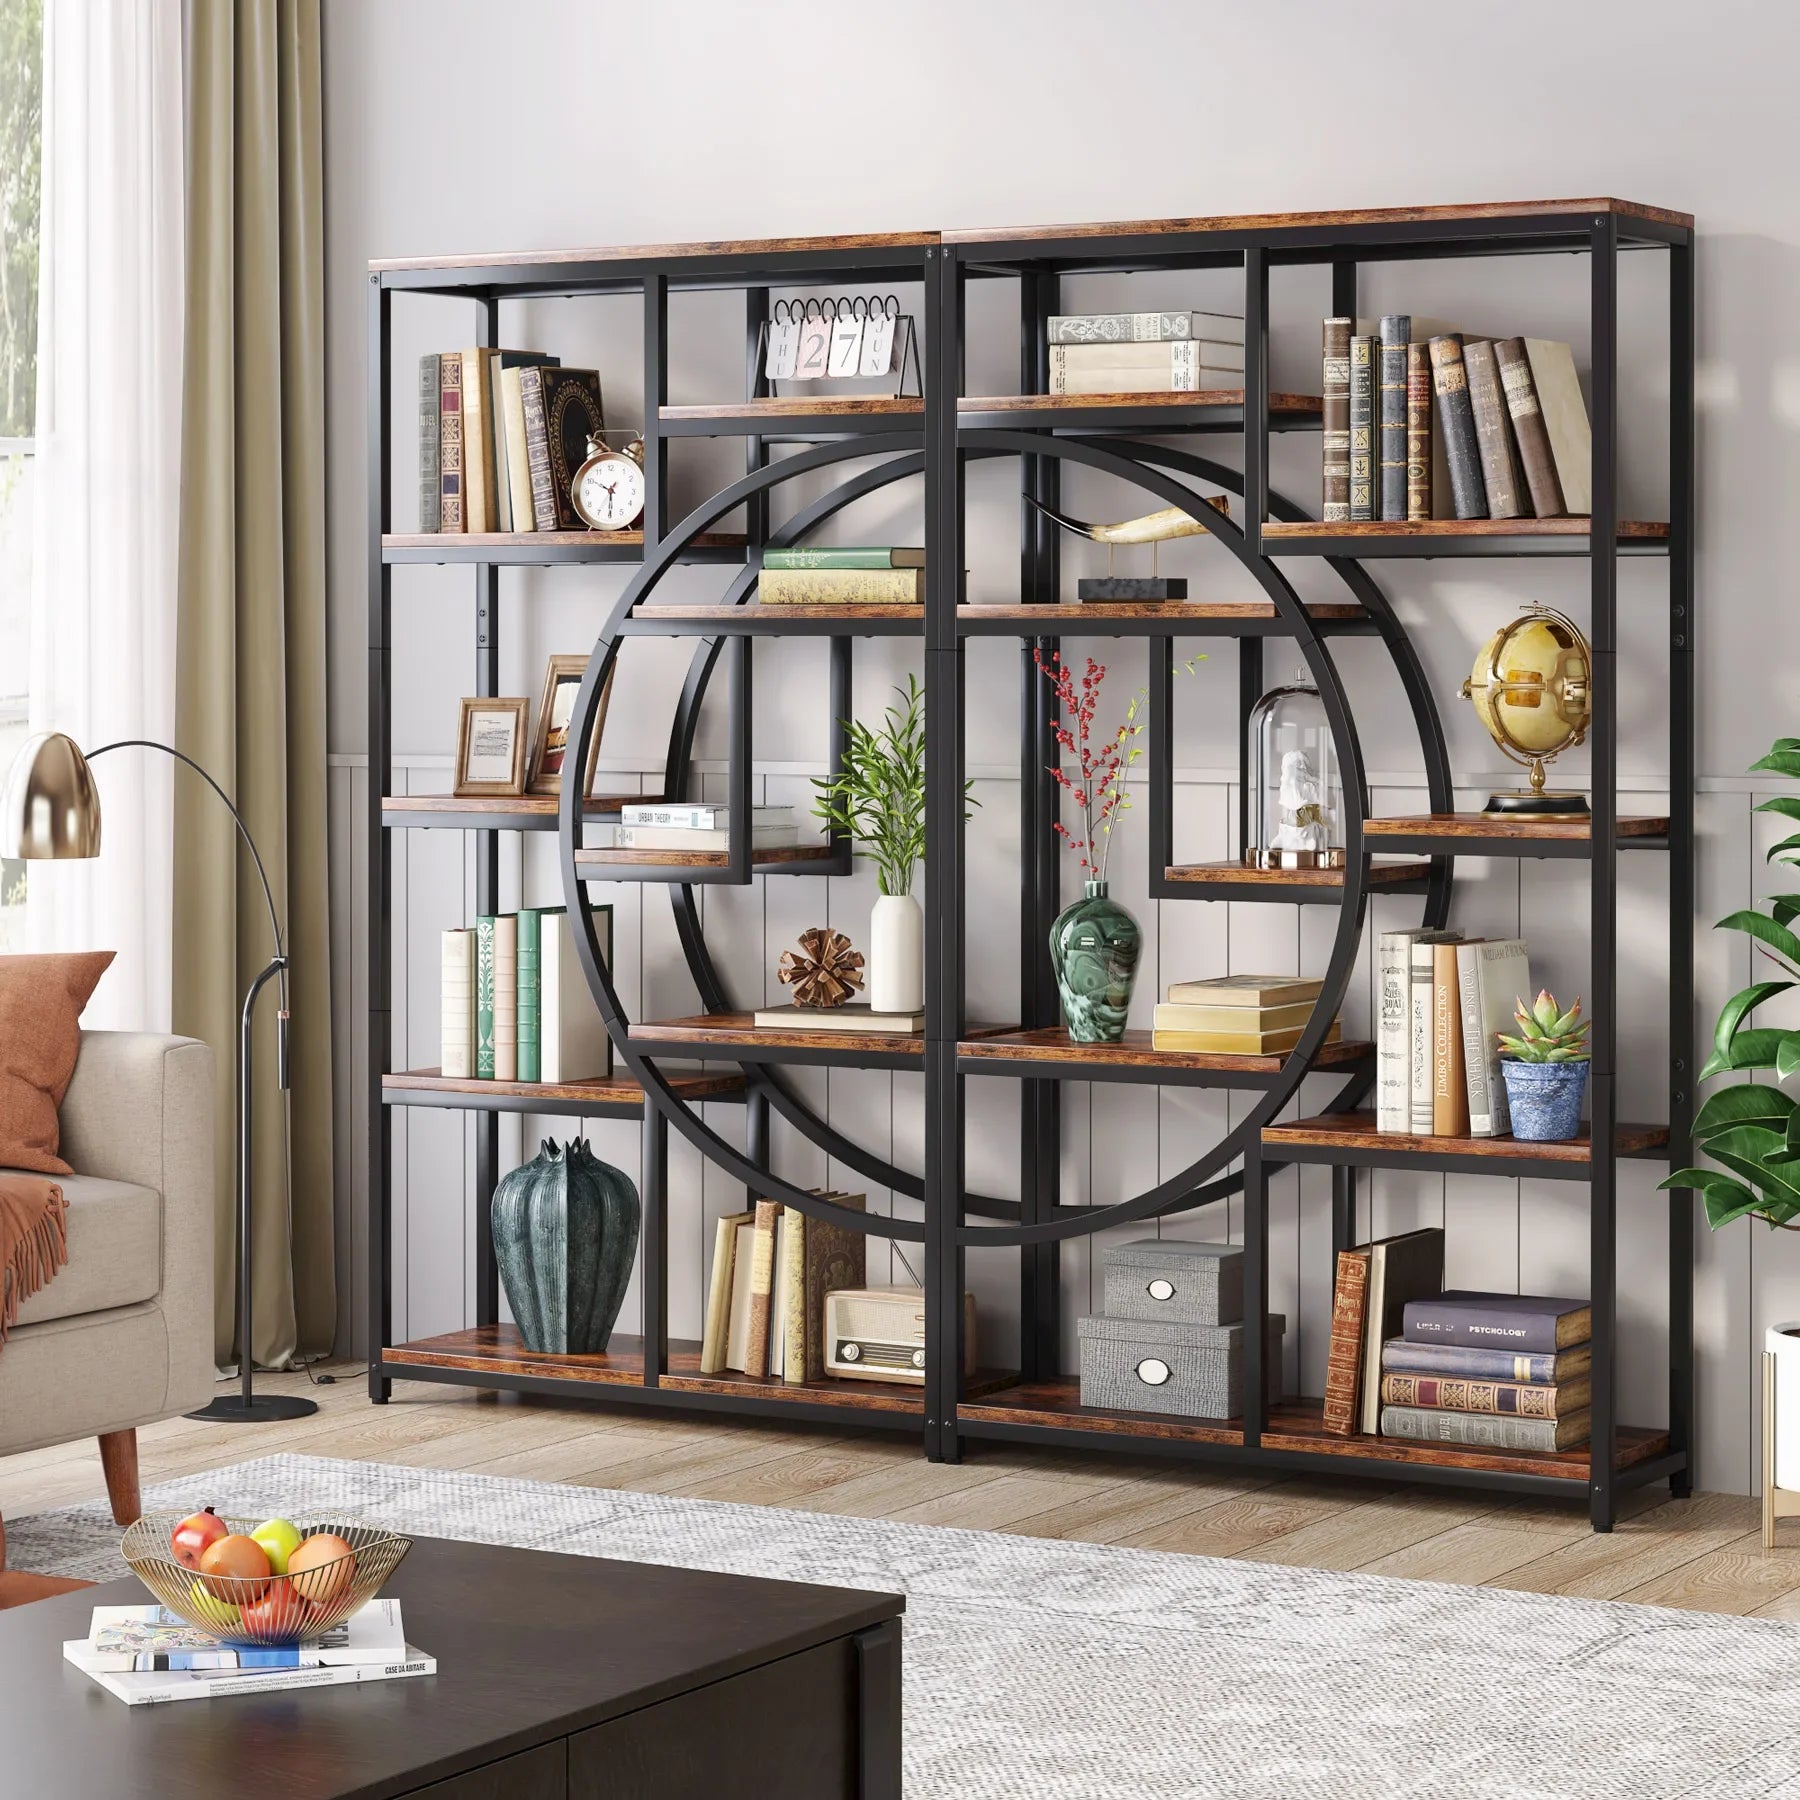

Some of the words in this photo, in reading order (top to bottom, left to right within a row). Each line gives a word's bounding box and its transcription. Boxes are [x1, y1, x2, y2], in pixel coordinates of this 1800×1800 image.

[638, 812, 653, 822] URBAN
[654, 813, 671, 823] THEORY
[1463, 968, 1476, 1014] YOUNG
[1436, 985, 1448, 1056] COLLECTION
[1465, 1027, 1481, 1053] THE
[1436, 1060, 1449, 1098] JUMBO
[1468, 1056, 1484, 1097] SHACK
[1469, 1326, 1527, 1337] PSYCHOLOGY
[385, 1666, 398, 1674] CASE
[406, 1663, 426, 1672] ABITARE
